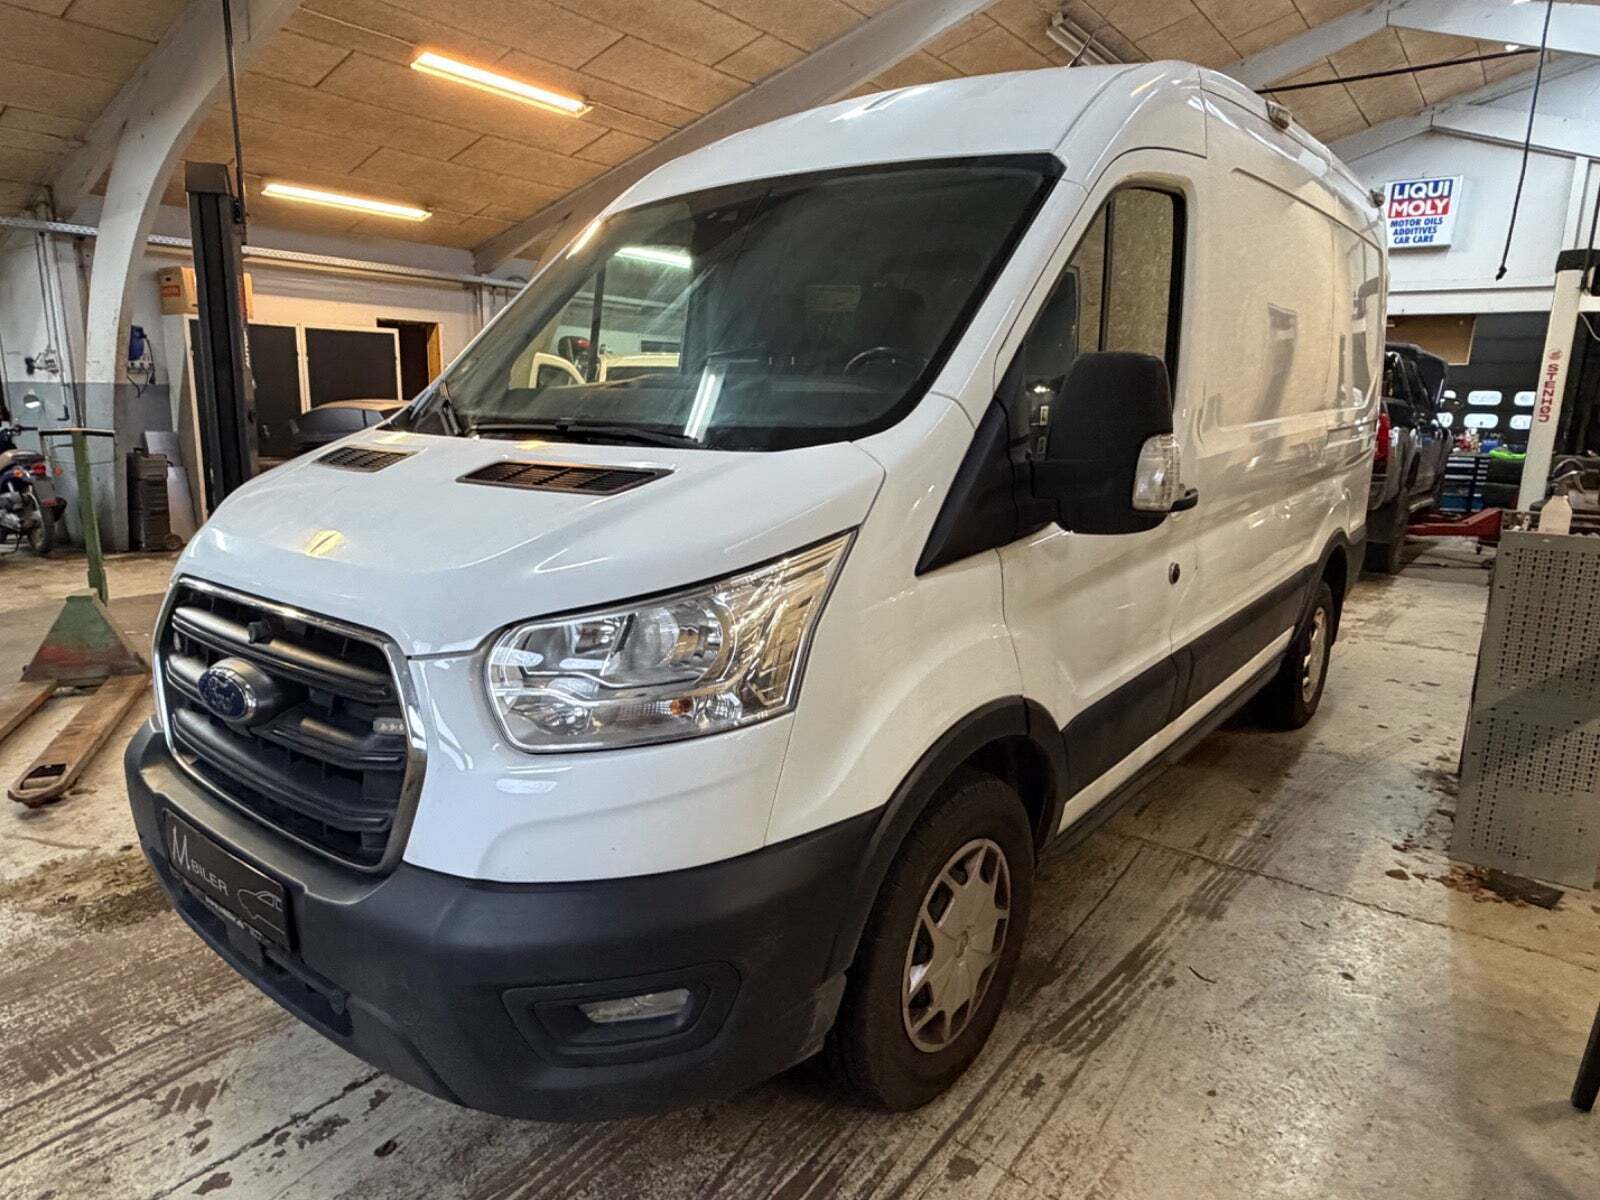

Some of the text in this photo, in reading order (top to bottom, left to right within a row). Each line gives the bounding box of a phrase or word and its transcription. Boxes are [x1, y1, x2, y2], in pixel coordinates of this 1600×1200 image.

[1393, 181, 1450, 200] LIQUI
[1390, 198, 1449, 217] MOLY
[1390, 217, 1443, 227] MOTOR OILS
[1393, 226, 1437, 236] ADDITIVES
[1394, 235, 1434, 244] CAR CARE
